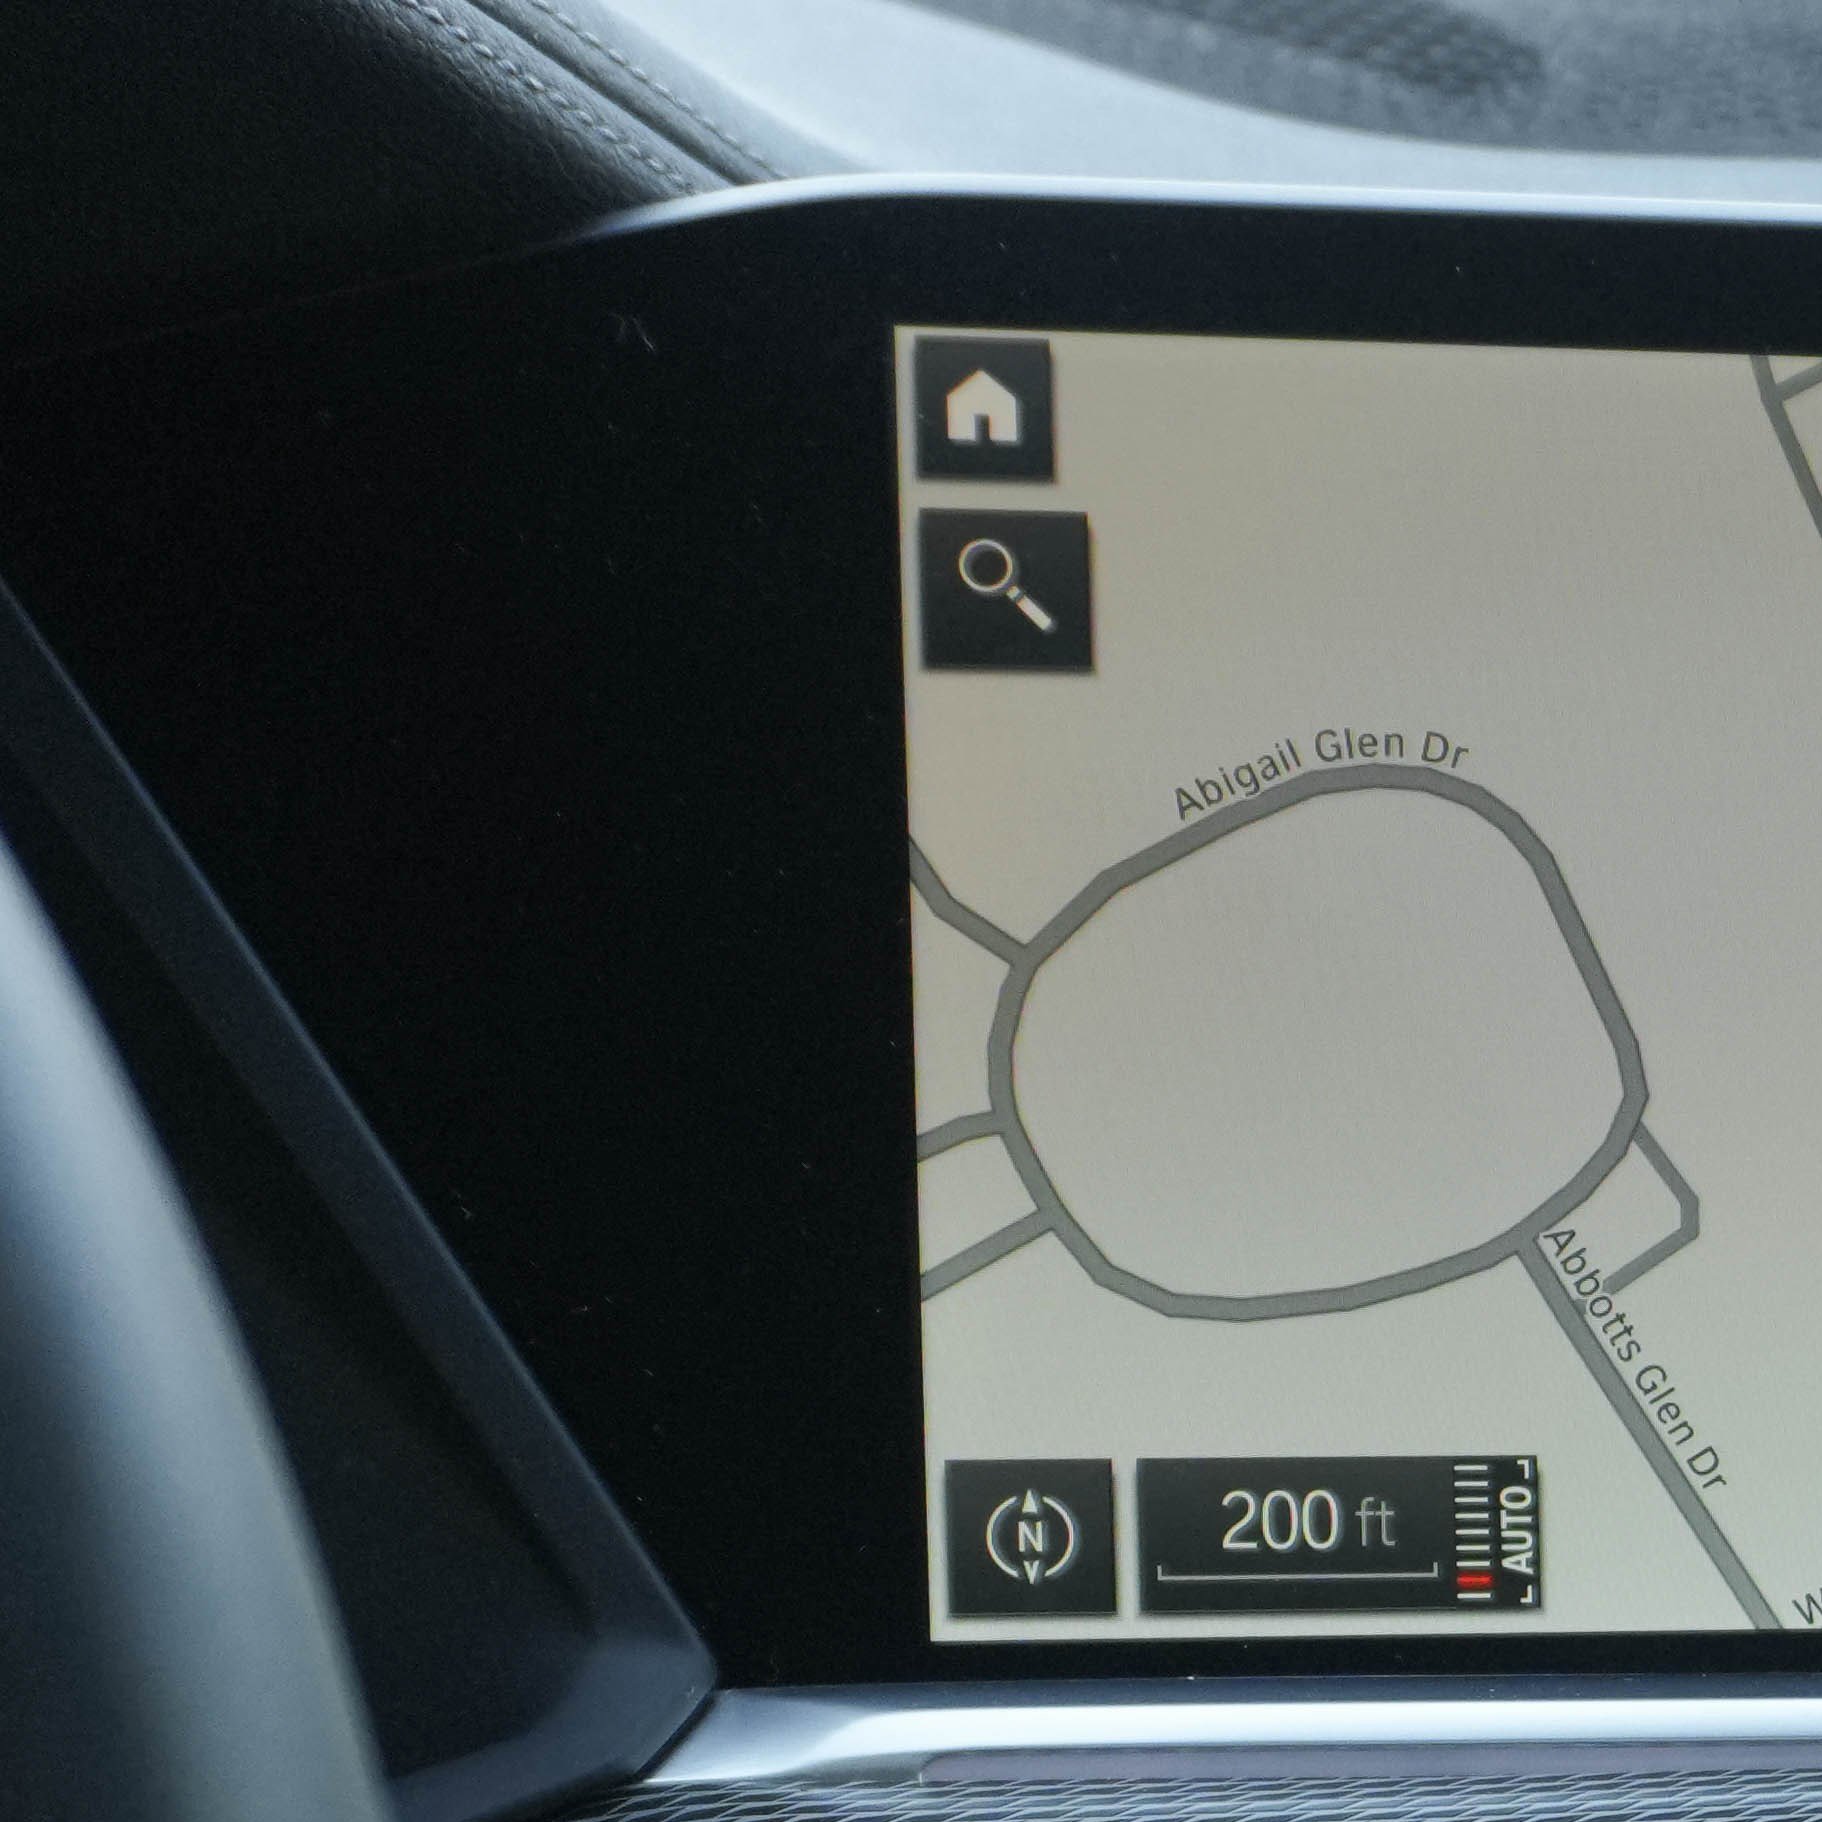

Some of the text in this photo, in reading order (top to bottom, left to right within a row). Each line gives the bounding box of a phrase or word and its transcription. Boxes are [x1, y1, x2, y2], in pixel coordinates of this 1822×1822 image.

[1174, 728, 1469, 820] Abigail Glen Dr
[1543, 1229, 1727, 1488] Abbotts Glen Dr
[1018, 1521, 1044, 1553] N
[1222, 1489, 1396, 1551] 200 ft
[1499, 1486, 1534, 1575] AUTO
